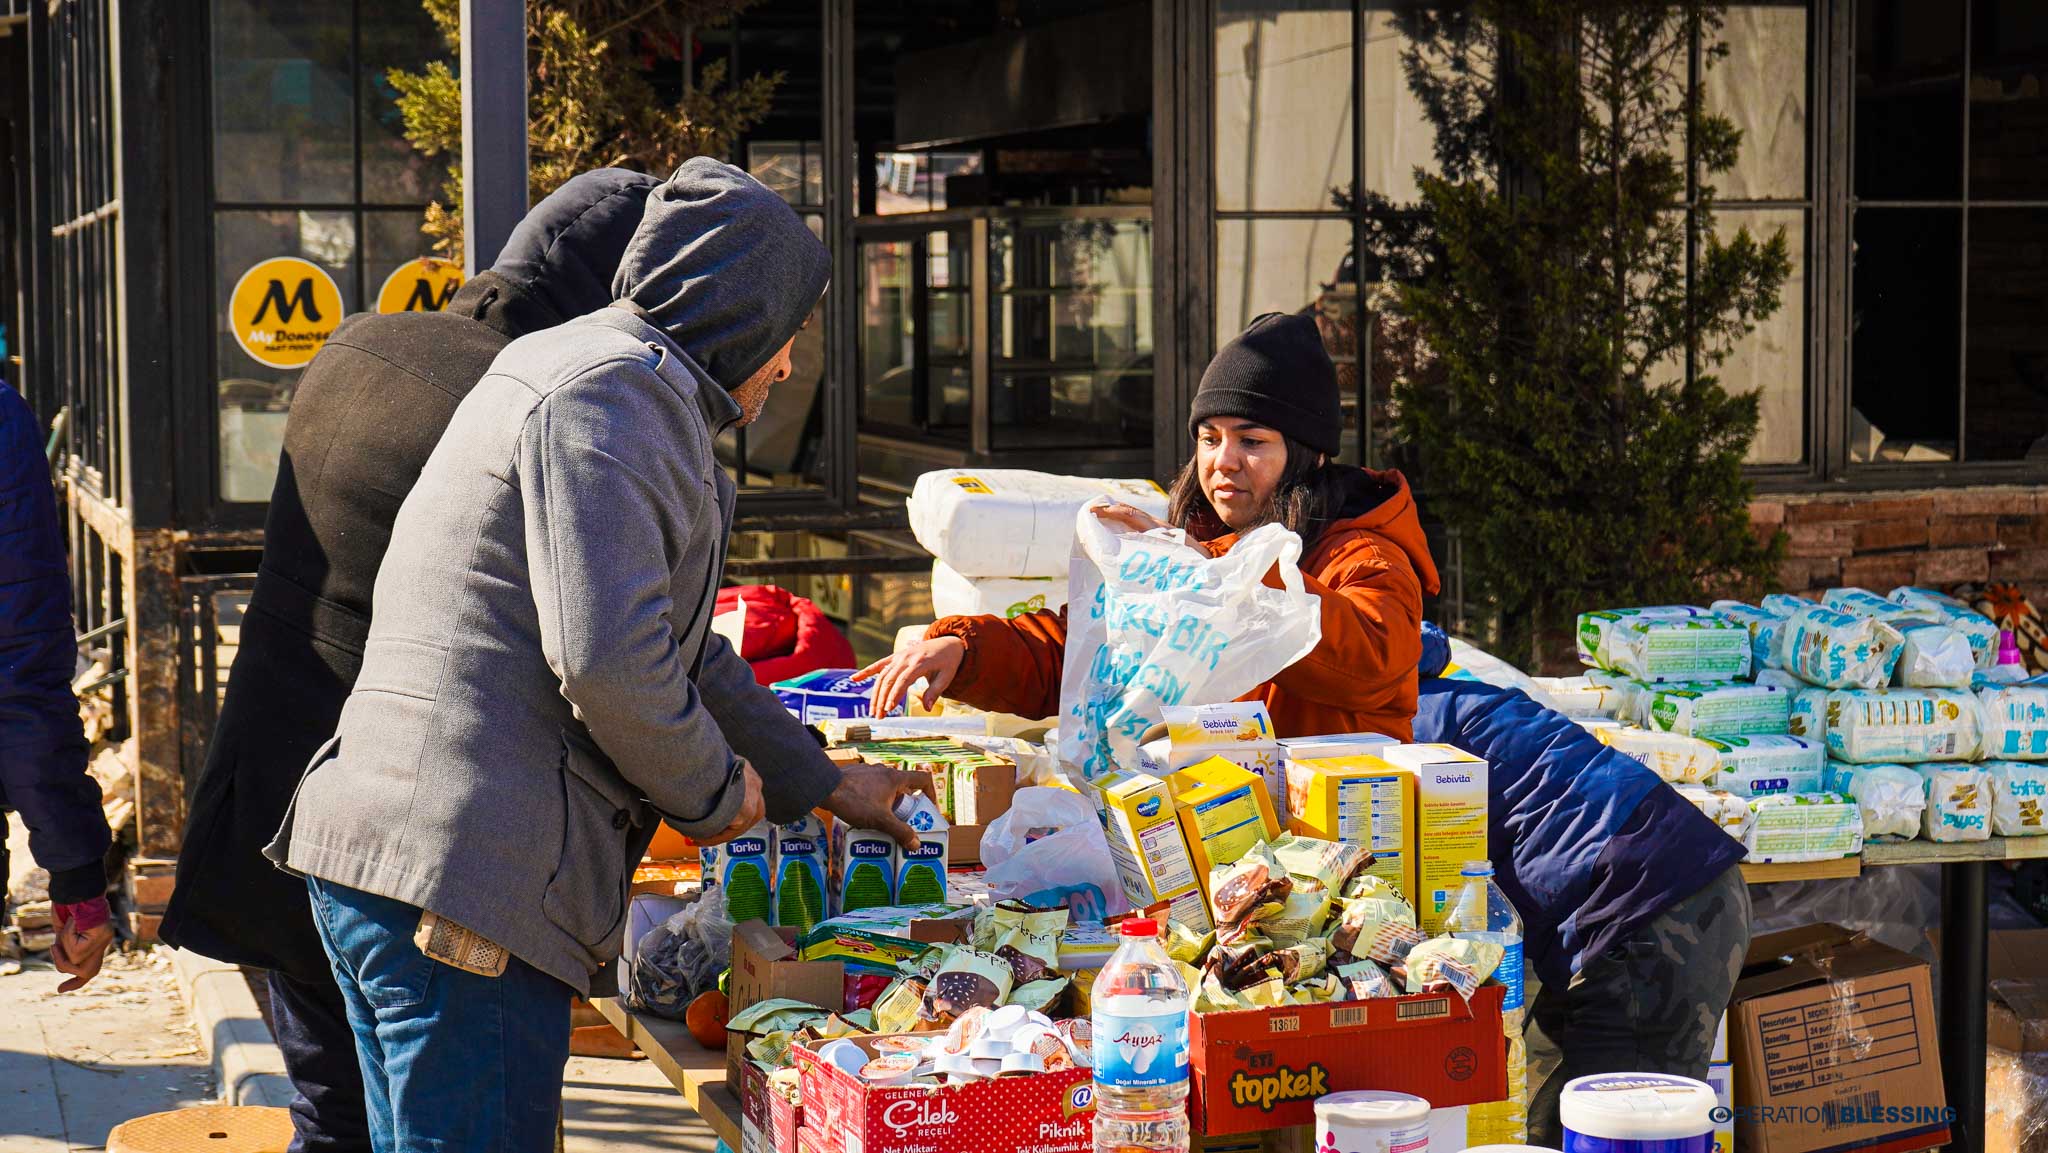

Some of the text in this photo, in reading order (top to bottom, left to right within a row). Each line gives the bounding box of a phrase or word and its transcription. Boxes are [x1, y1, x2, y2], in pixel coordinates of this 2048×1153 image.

[251, 278, 322, 326] M
[1653, 707, 1677, 722] molped
[1203, 718, 1238, 729] Bebivita
[1253, 712, 1267, 734] 1
[1435, 774, 1471, 784] Bebivita
[731, 841, 761, 853] Torku
[783, 840, 812, 851] Torku
[854, 842, 886, 855] Torku
[1762, 1015, 1797, 1029] Description
[1232, 1065, 1328, 1108] topkek
[884, 1088, 945, 1100] GELENEKEL
[883, 1098, 959, 1138] Çilek
[1040, 1120, 1086, 1139] Piknik
